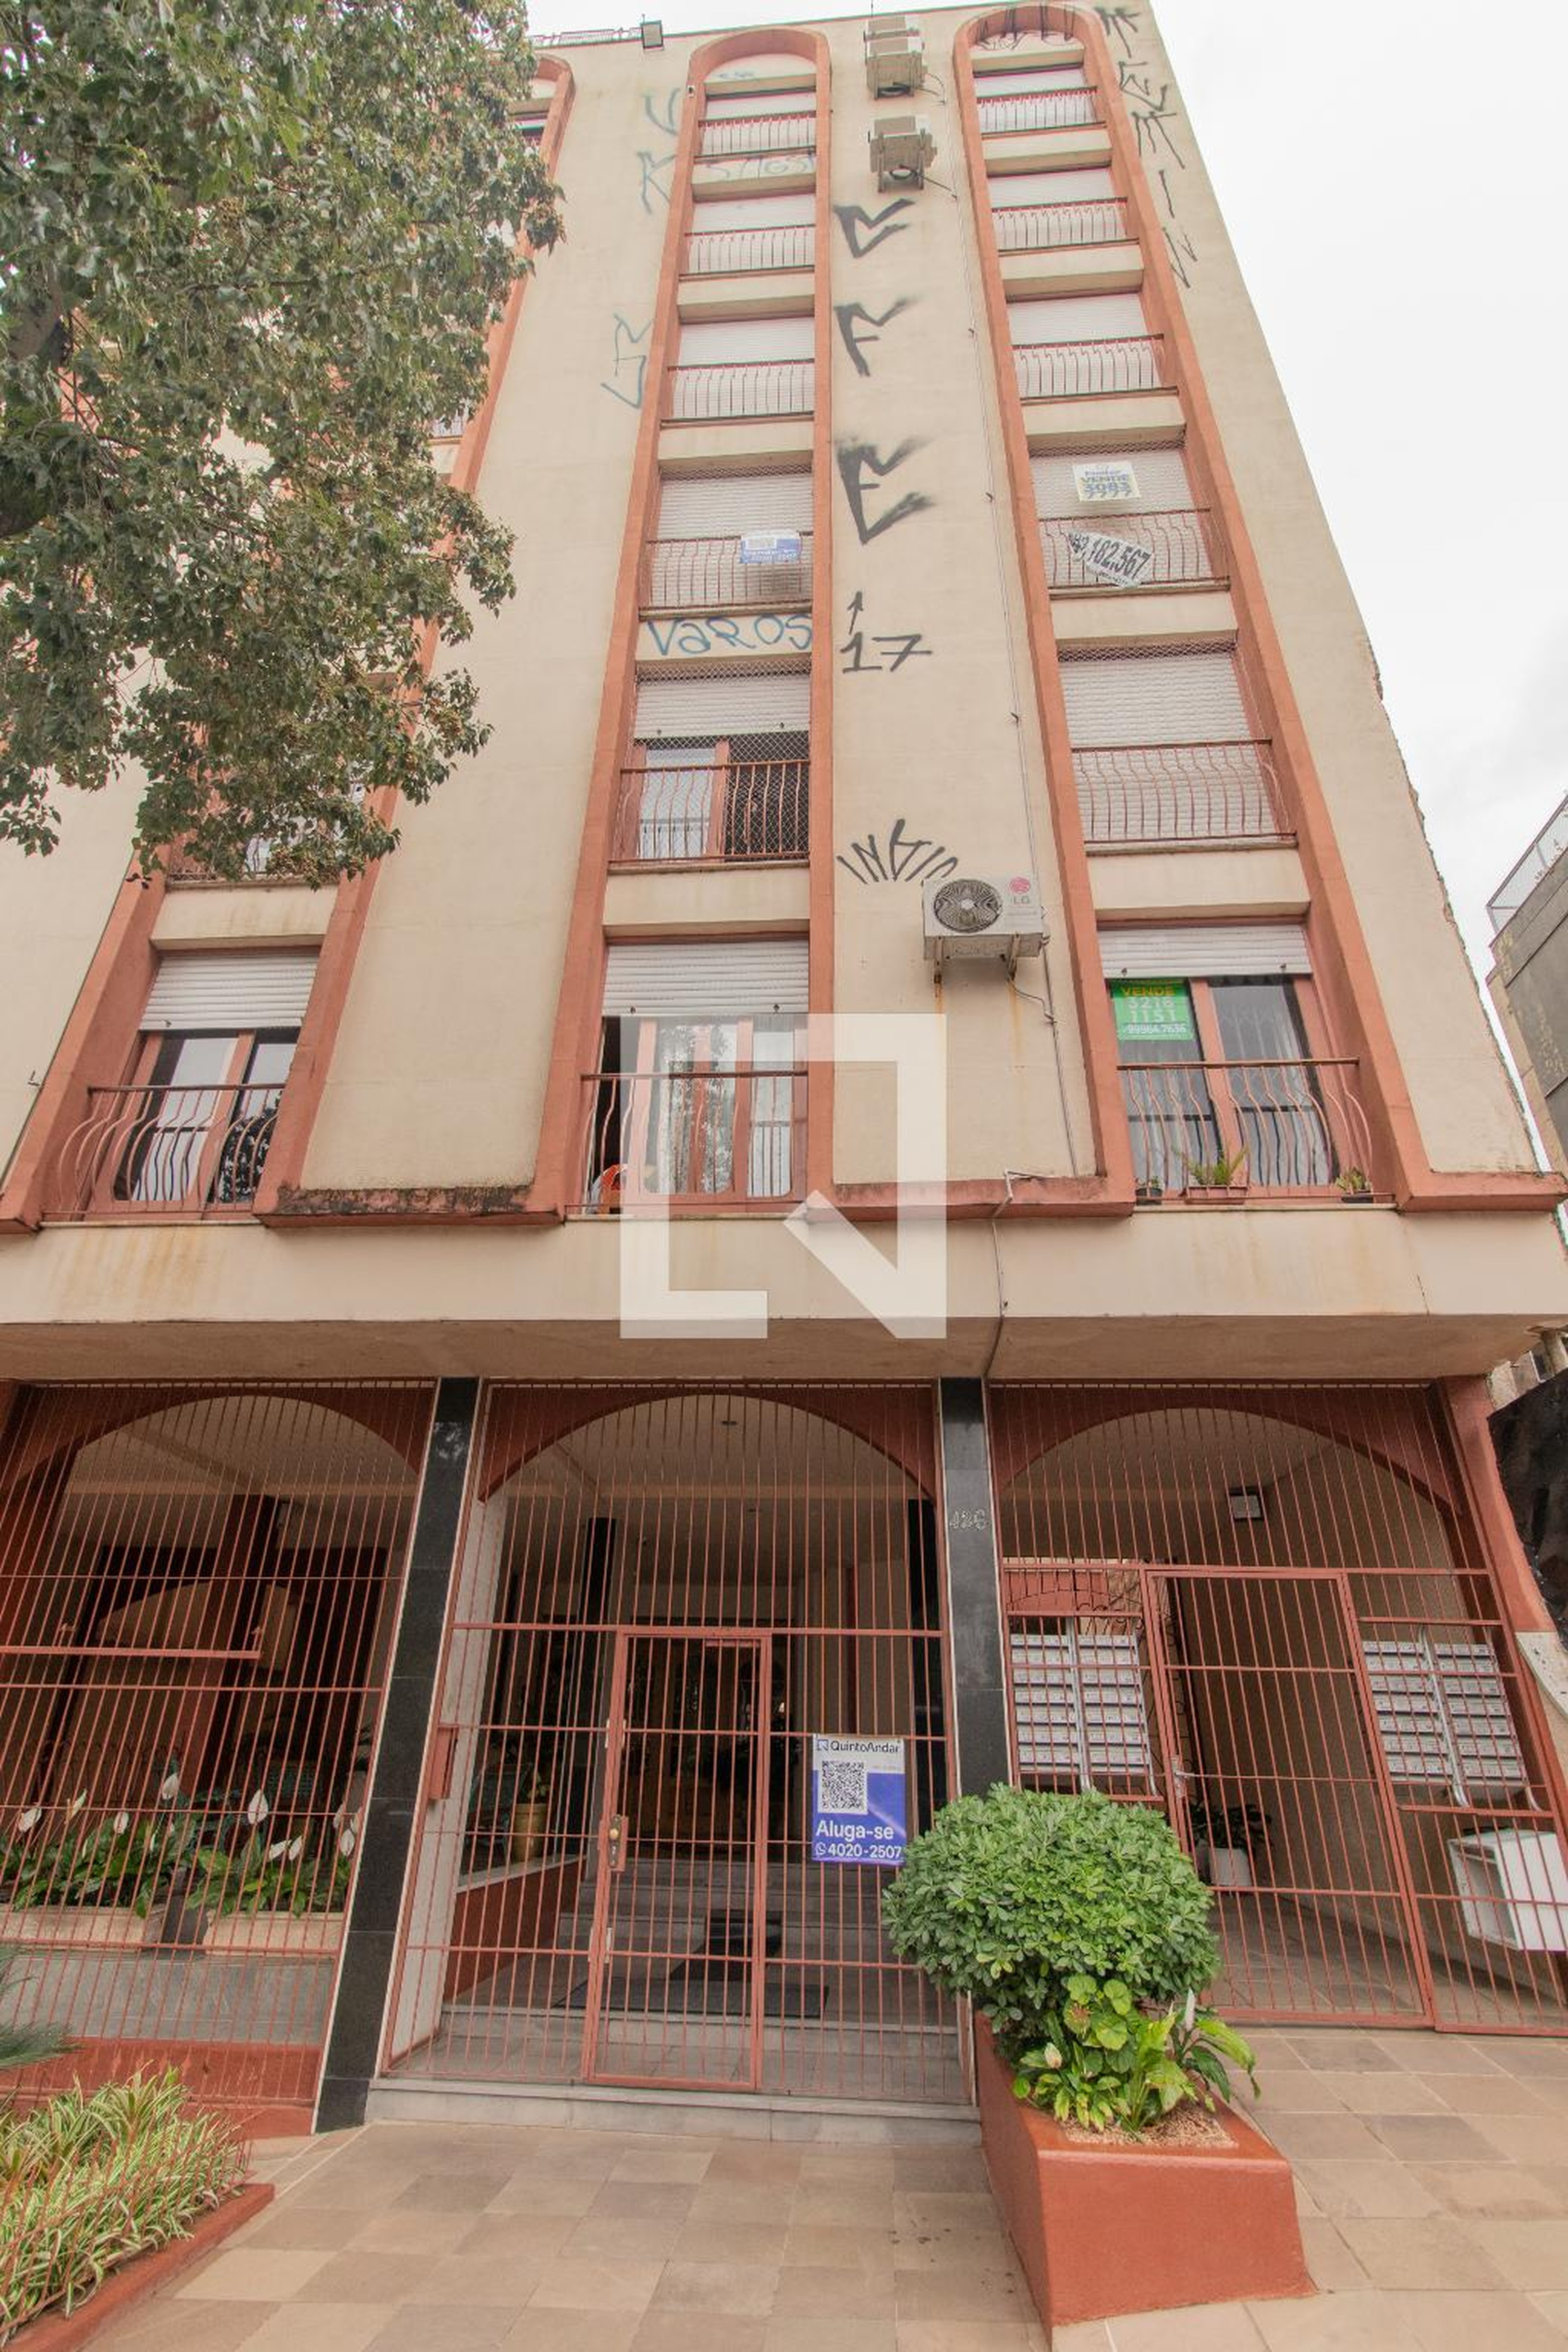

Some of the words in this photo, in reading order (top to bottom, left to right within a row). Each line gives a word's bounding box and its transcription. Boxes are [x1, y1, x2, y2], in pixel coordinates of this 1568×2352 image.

[1122, 986, 1175, 996] VENDE
[830, 1740, 899, 1753] QuintoAndar
[816, 1820, 894, 1842] Aluga-se
[827, 1843, 902, 1858] 4020-2507
